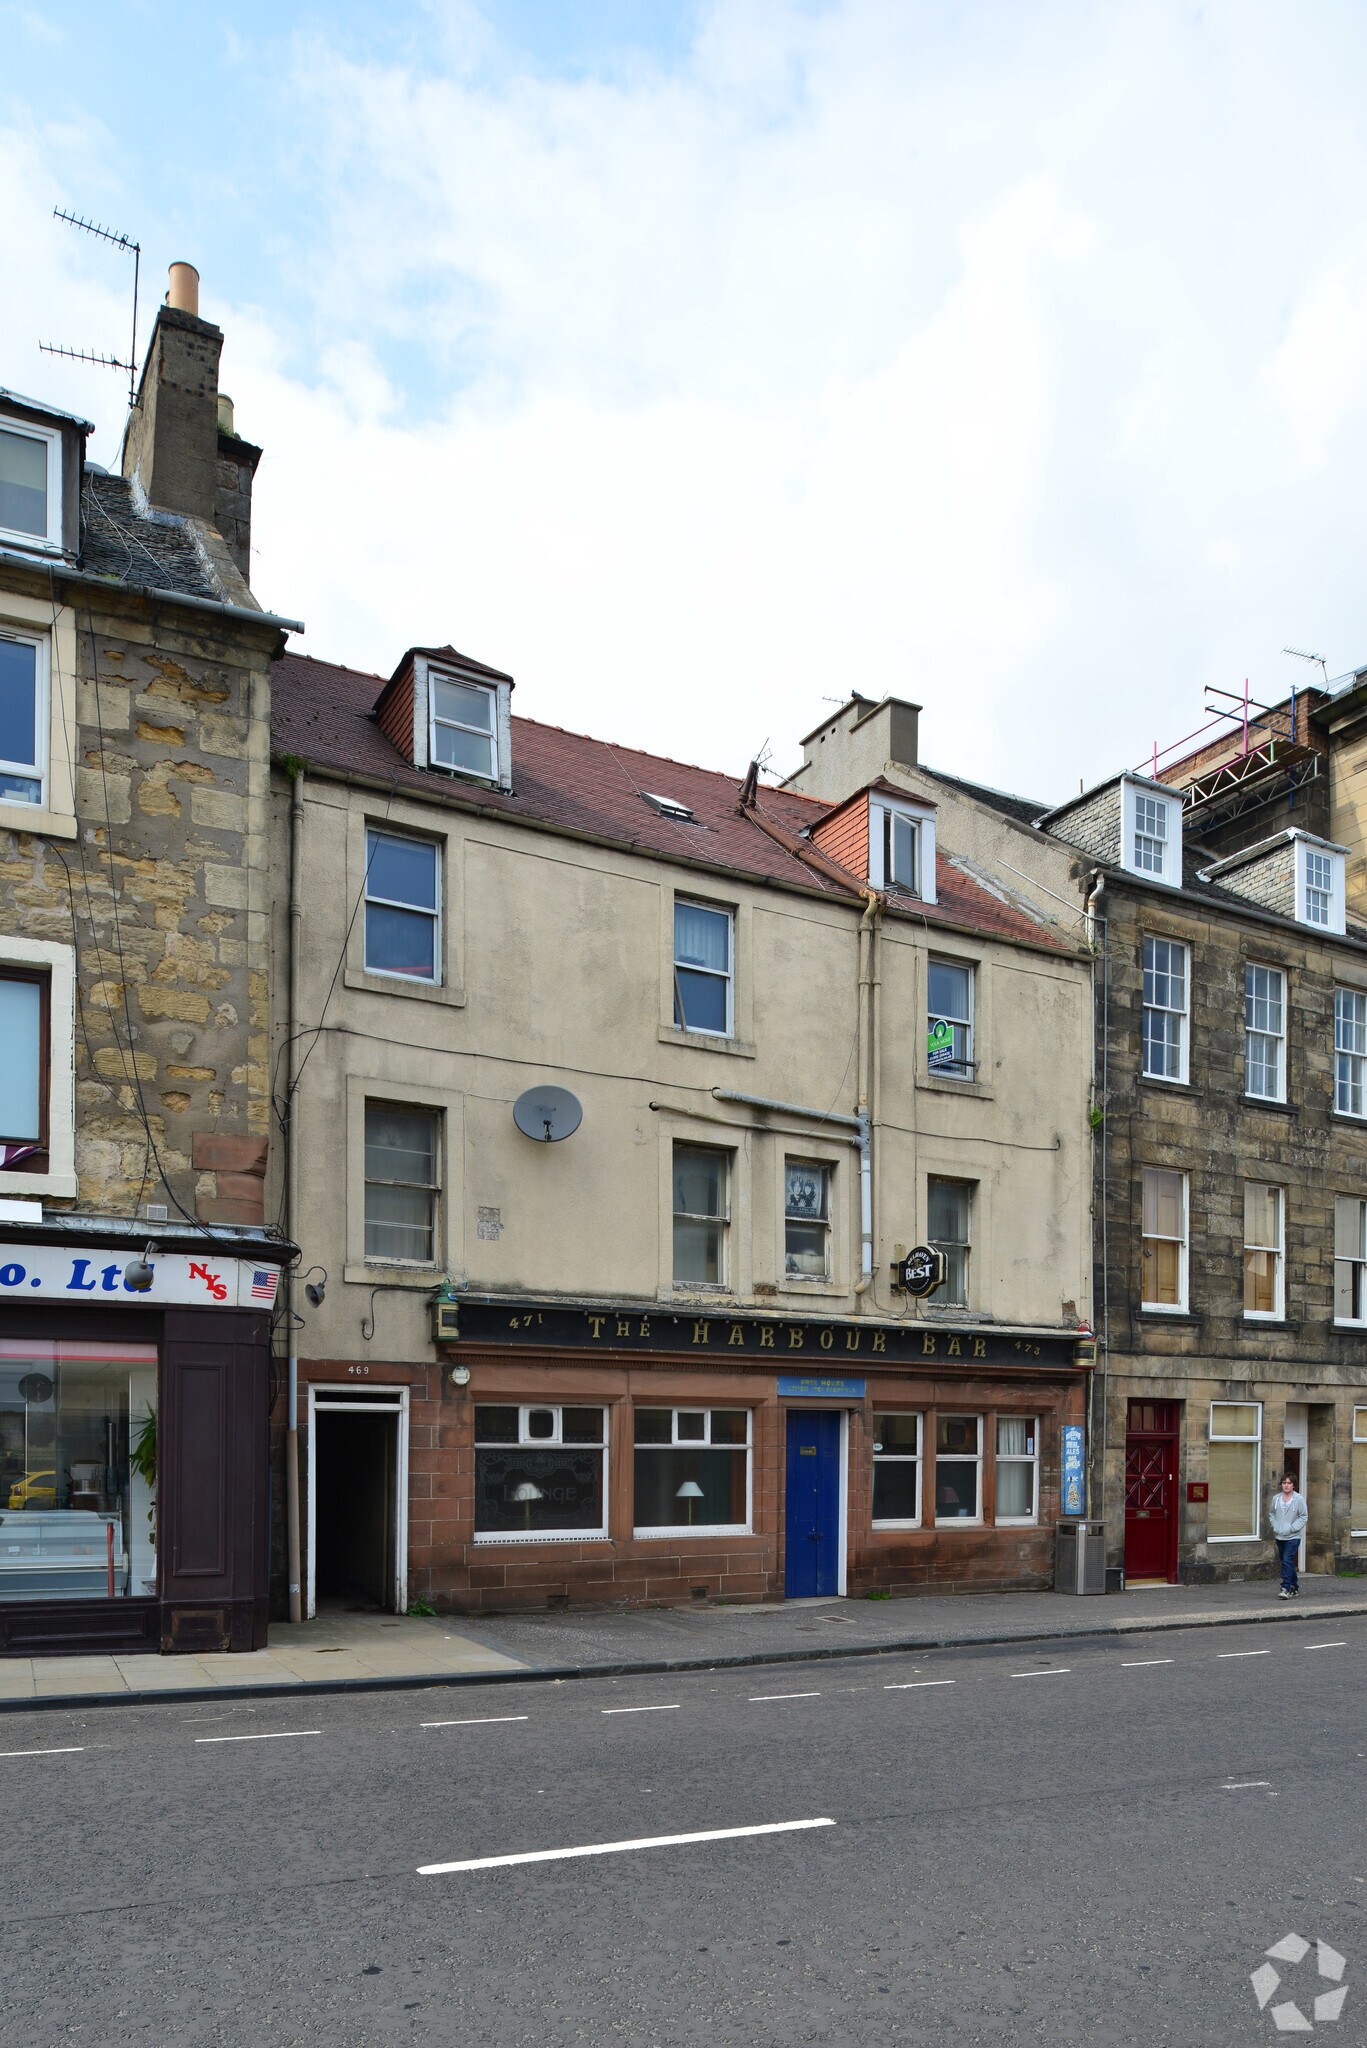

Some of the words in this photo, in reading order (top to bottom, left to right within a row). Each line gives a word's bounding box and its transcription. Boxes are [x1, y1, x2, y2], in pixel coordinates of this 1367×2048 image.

[905, 1264, 933, 1281] BEST
[189, 1263, 227, 1300] NYS
[509, 1313, 543, 1329] 471
[588, 1316, 650, 1338] THE
[692, 1321, 886, 1353] HARBOUR
[922, 1335, 986, 1358] BAR
[1014, 1340, 1041, 1356] 473
[348, 1366, 369, 1374] 469
[503, 1484, 577, 1504] LOUNGE
